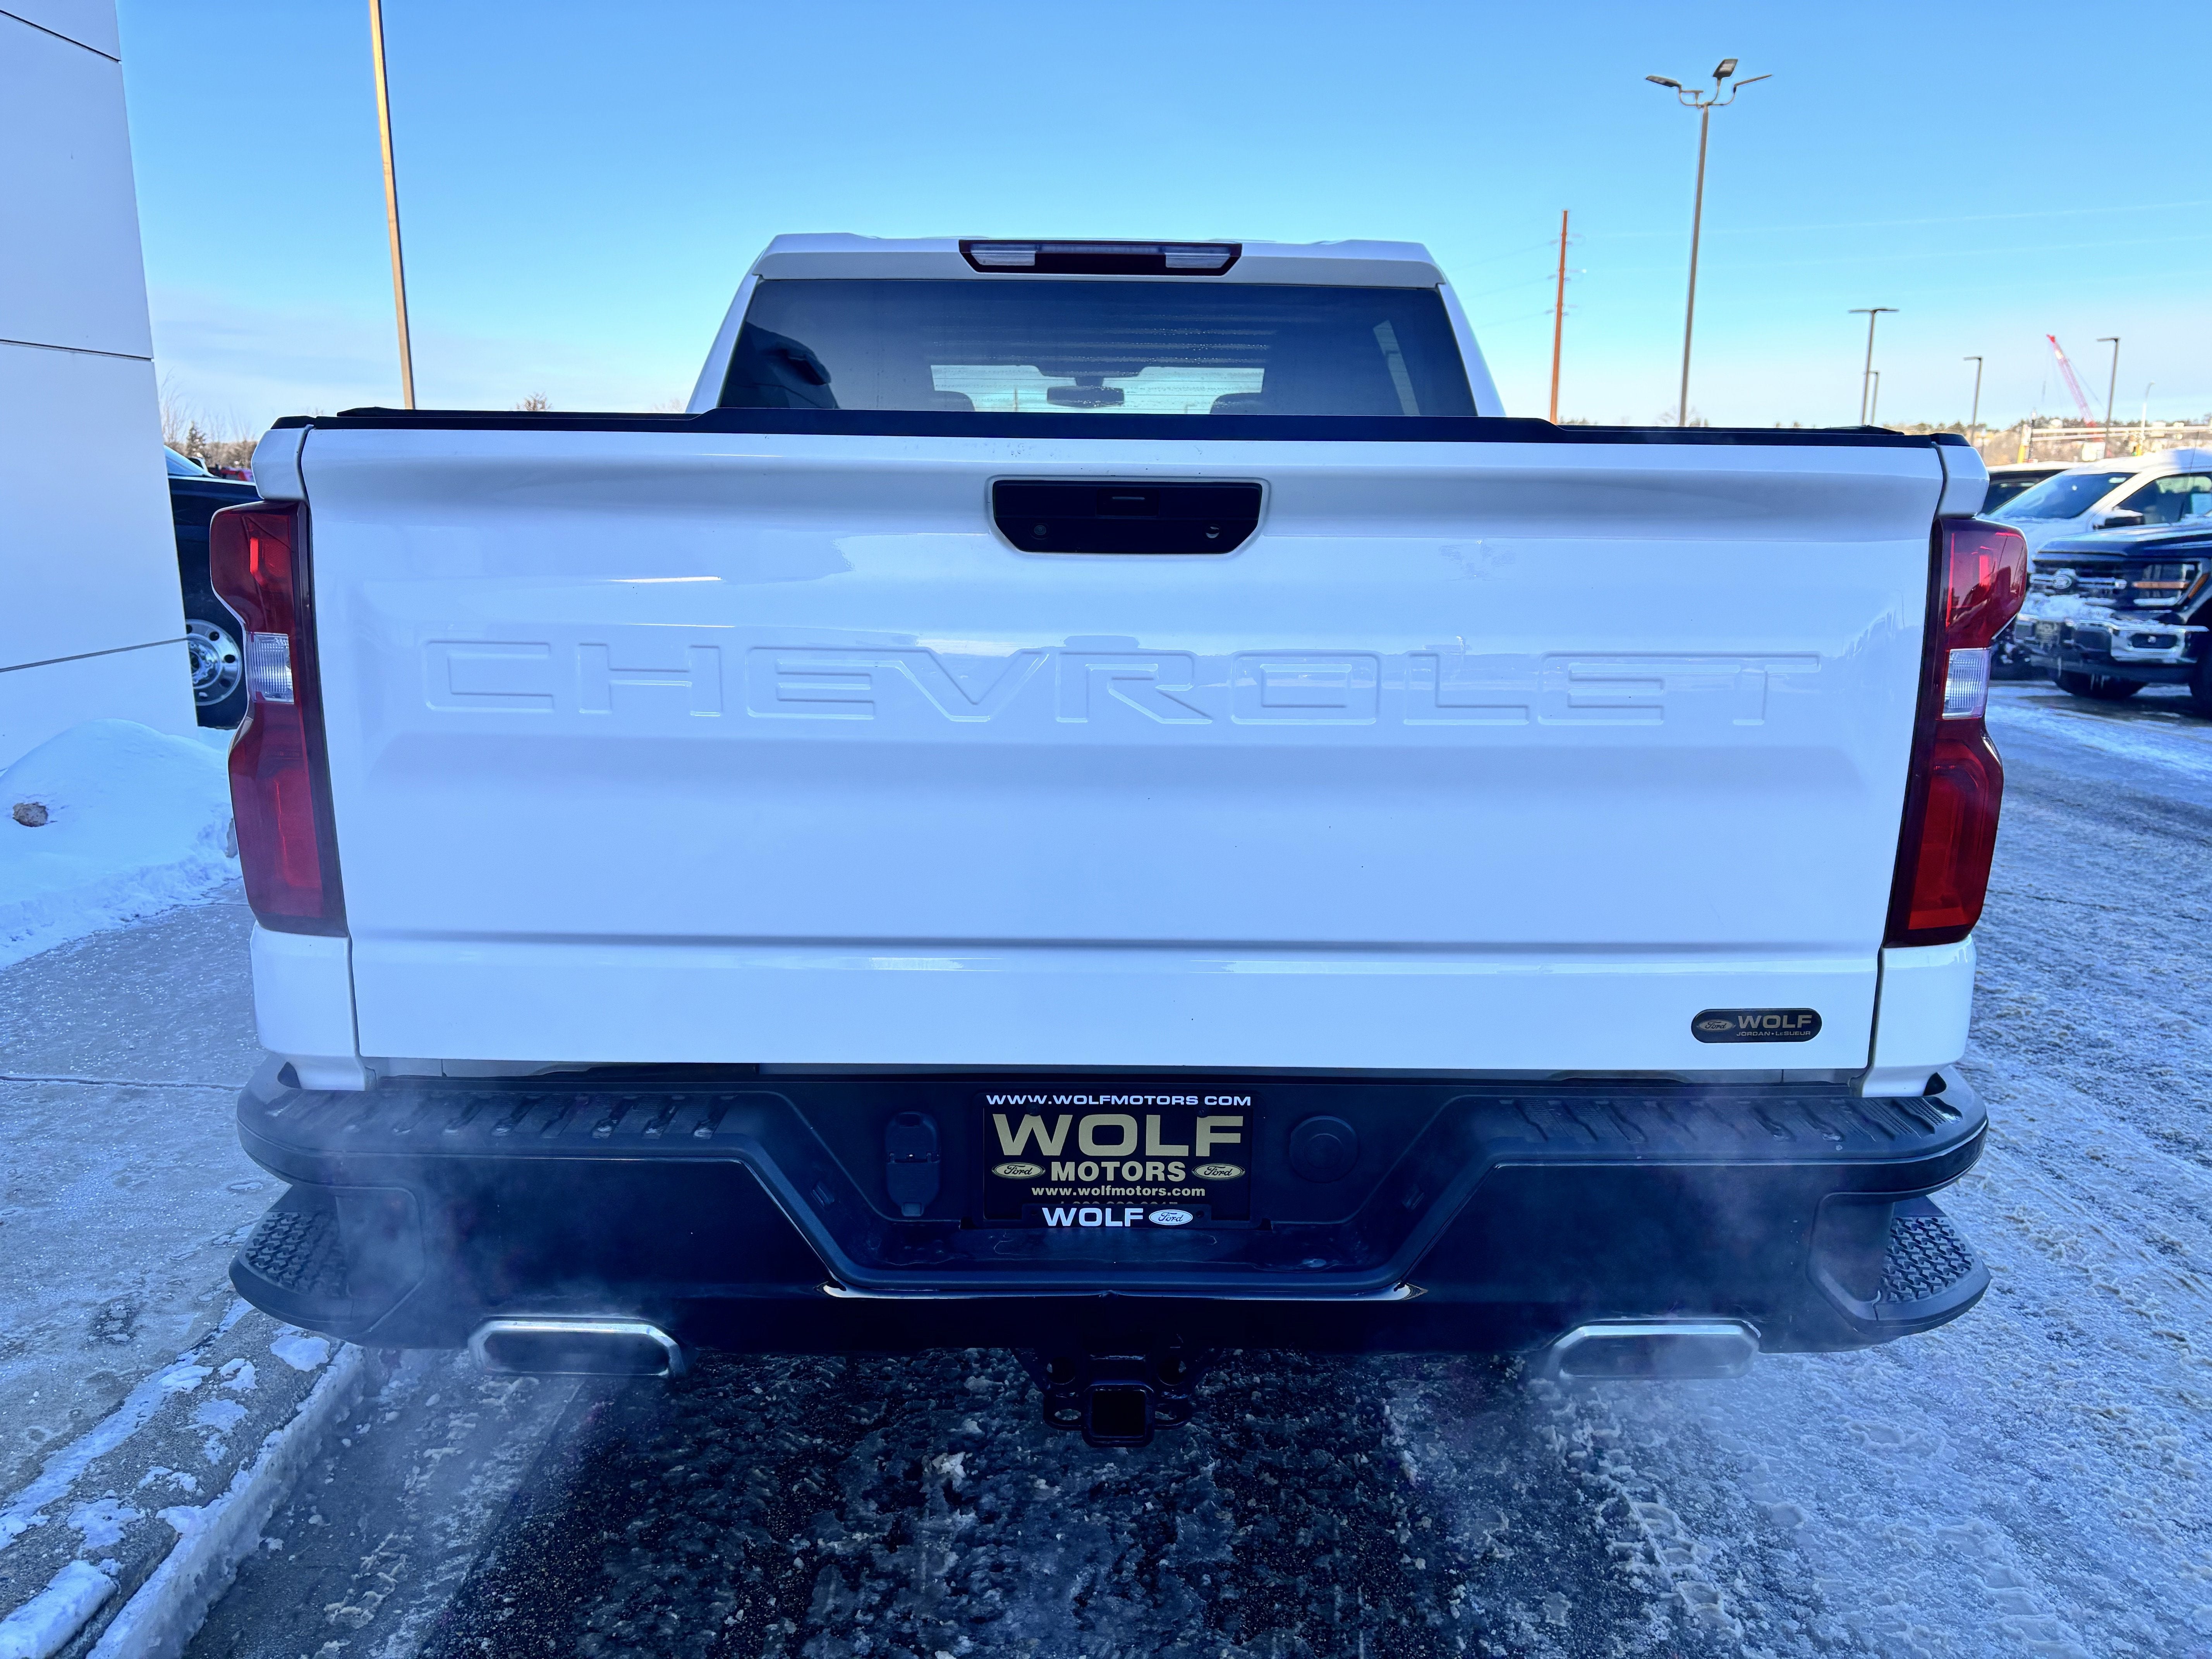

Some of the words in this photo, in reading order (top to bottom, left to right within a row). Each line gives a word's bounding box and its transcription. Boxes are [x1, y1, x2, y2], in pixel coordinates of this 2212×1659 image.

[423, 638, 1821, 726] CHEVROLET
[1738, 1015, 1812, 1029] WOLF
[986, 1095, 1250, 1106] WWW.WOLFMOTORSCOM
[993, 1114, 1243, 1156] WOLF
[1051, 1161, 1186, 1182] MOTORS
[1032, 1185, 1205, 1196] www.wolfmotors.com
[1042, 1207, 1143, 1227] WOLF
